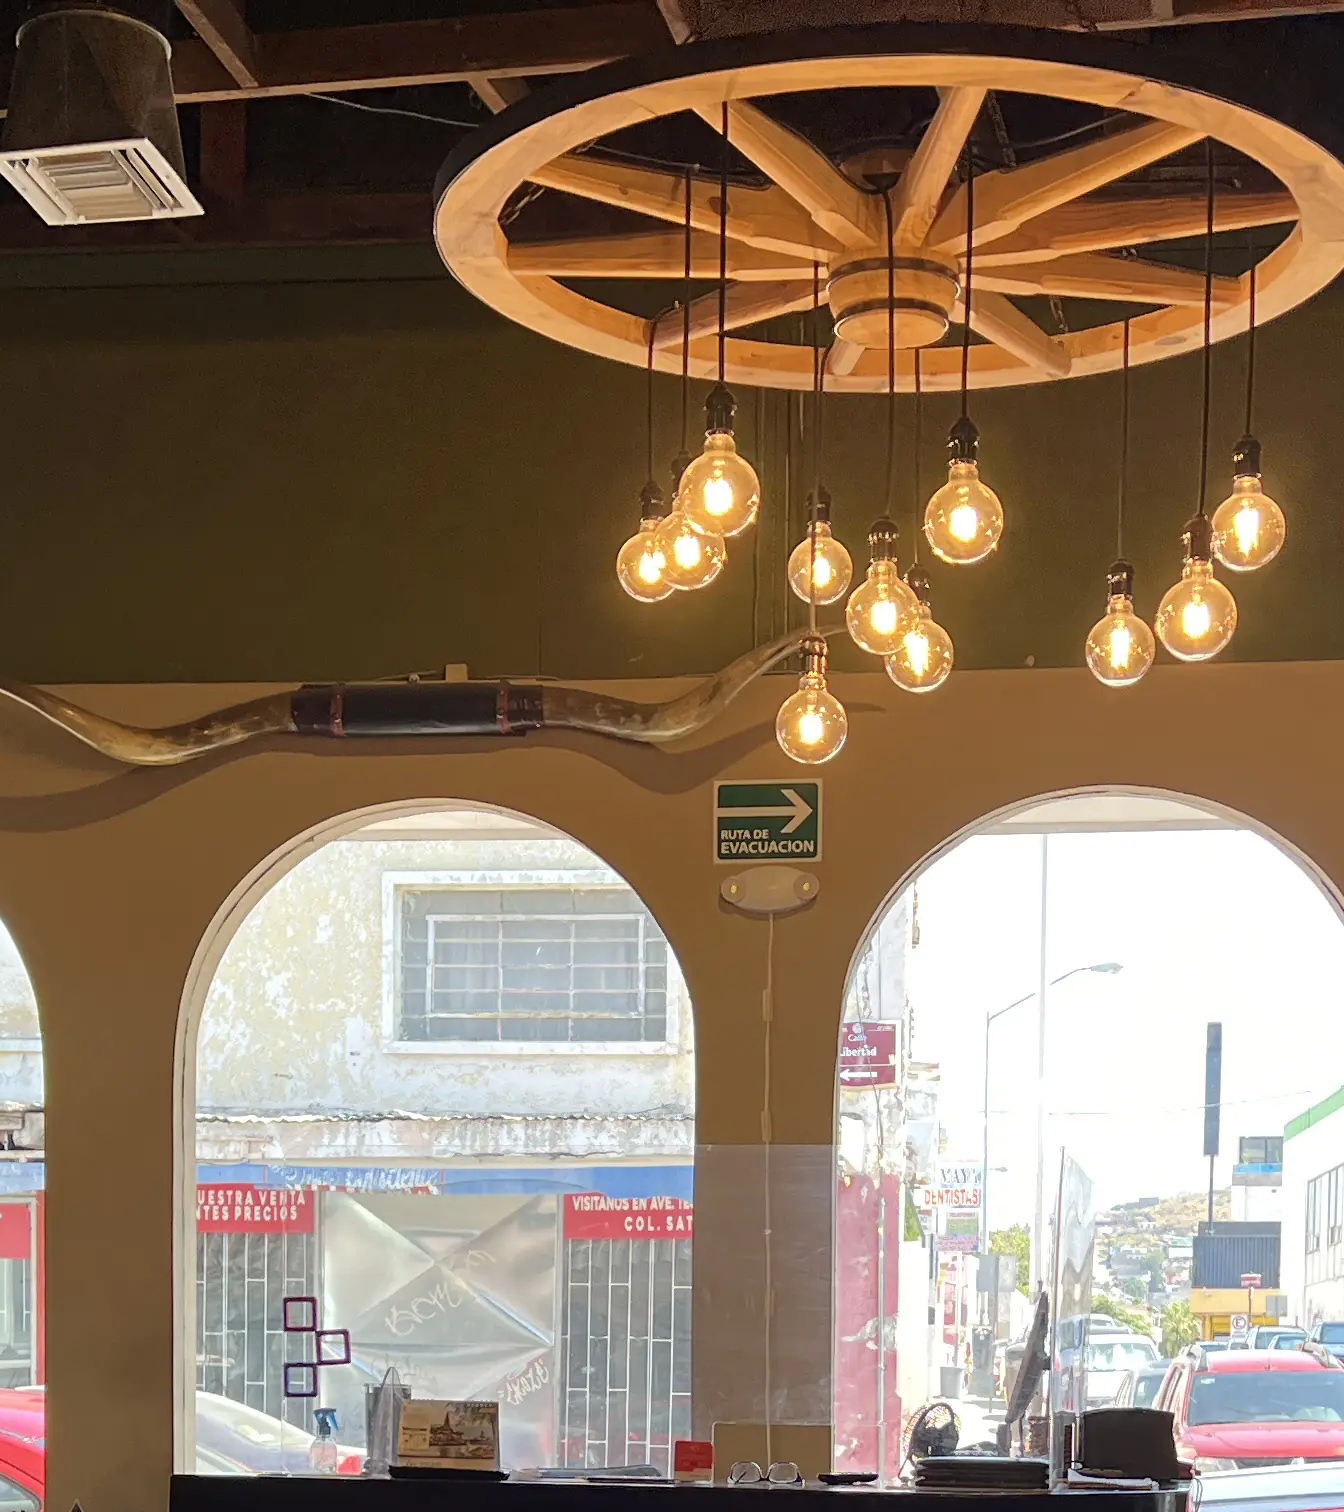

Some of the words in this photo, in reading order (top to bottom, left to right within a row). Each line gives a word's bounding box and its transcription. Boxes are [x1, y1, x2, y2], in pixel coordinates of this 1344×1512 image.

[720, 829, 751, 840] RUTA
[753, 829, 769, 840] DE
[720, 840, 815, 854] EVACUACION
[197, 1189, 254, 1206] UESTRA
[258, 1190, 305, 1206] VENTA
[632, 1197, 647, 1210] EN
[924, 1188, 978, 1205] DENTISTAS
[234, 1205, 297, 1222] PRECIOS
[624, 1215, 661, 1232] COL.
[666, 1215, 693, 1232] SAT
